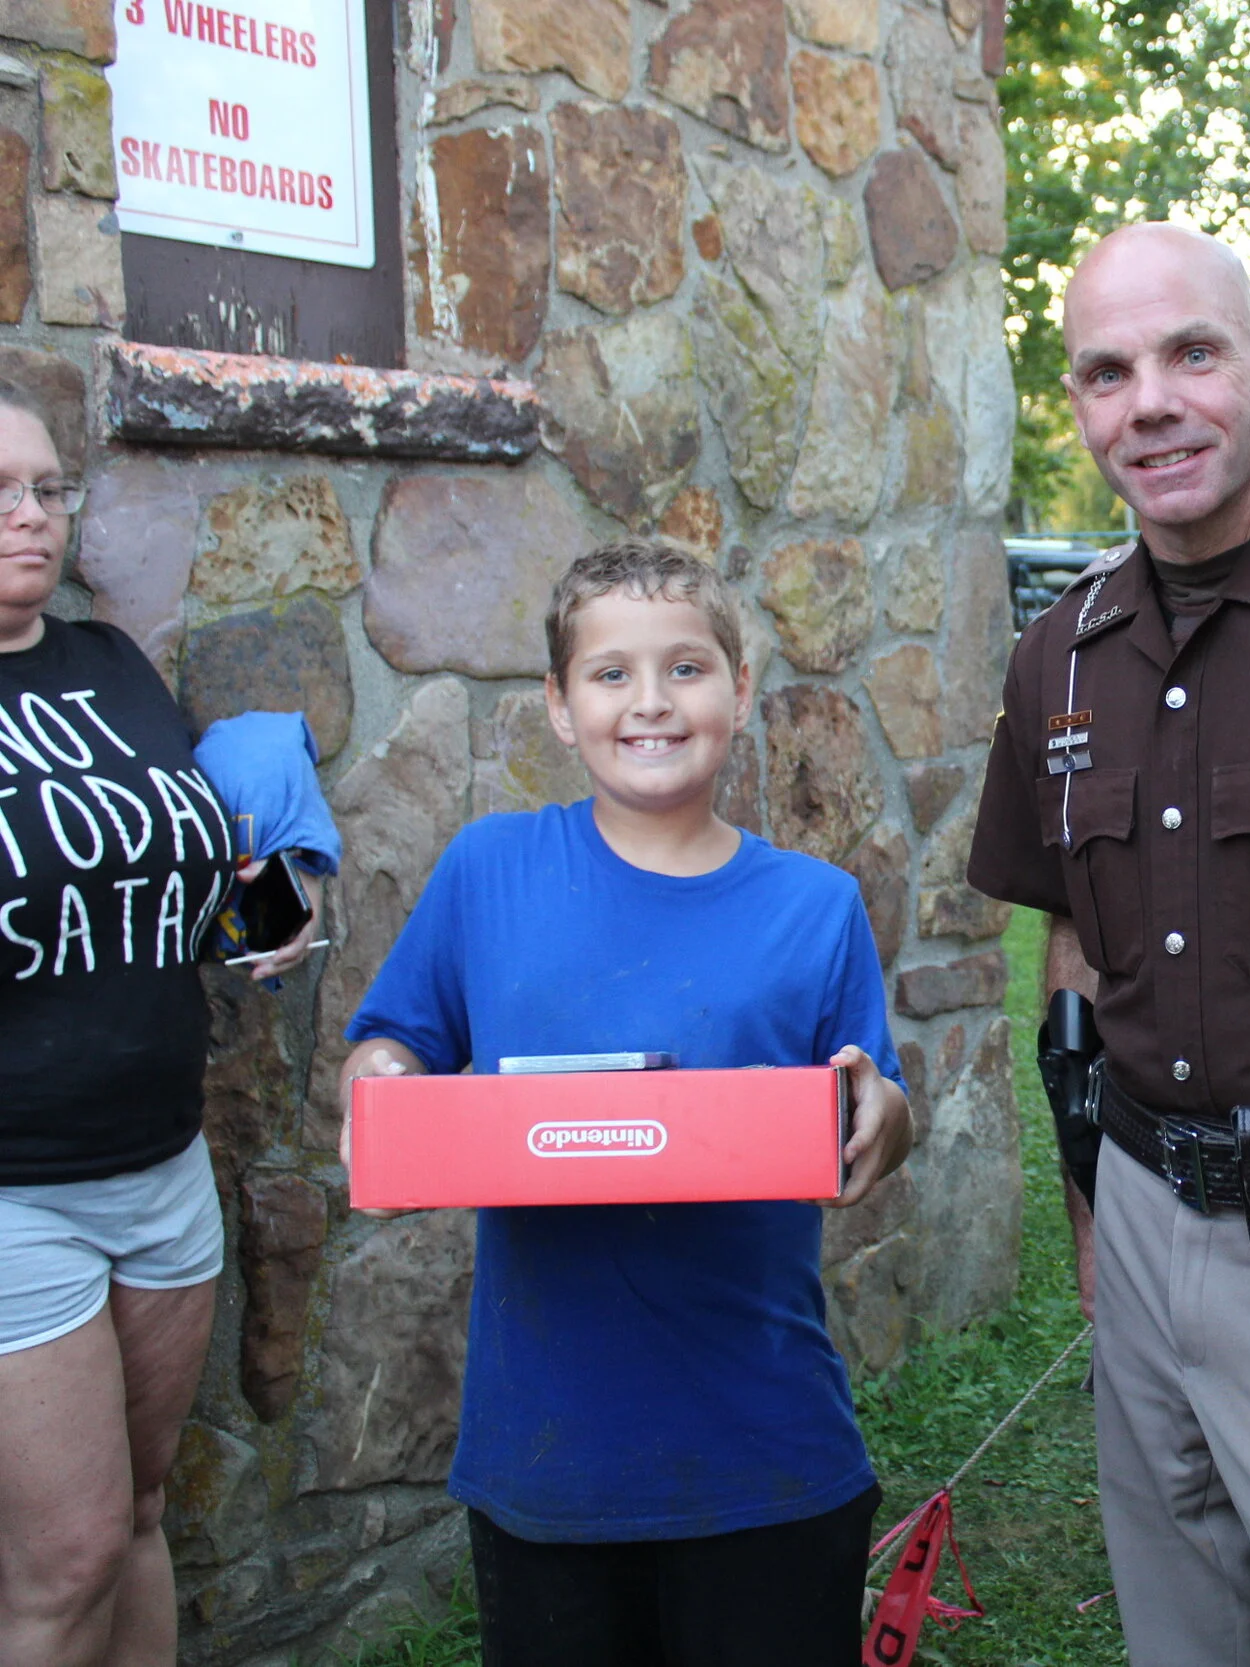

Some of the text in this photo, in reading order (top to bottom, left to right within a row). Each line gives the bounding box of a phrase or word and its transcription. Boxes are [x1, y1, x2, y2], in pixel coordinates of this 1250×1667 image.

[126, 0, 317, 68] 3 WHEELERS
[209, 98, 250, 141] NO
[120, 136, 333, 210] SKATEBOARDS
[0, 766, 232, 878] TODAY
[539, 1128, 655, 1149] Nintendo
